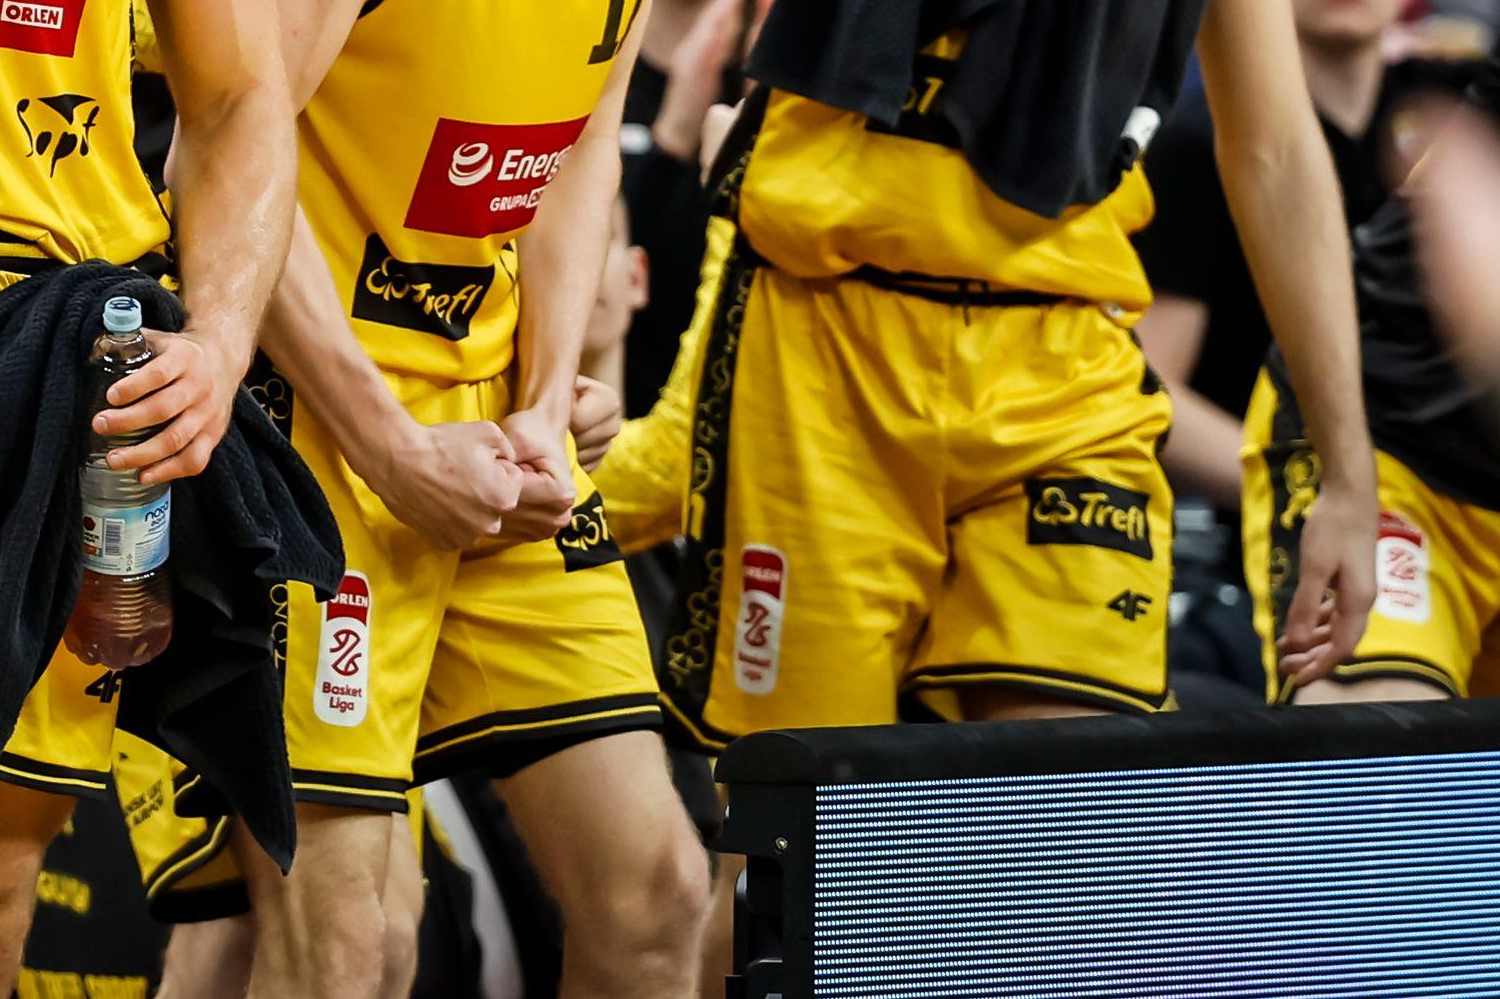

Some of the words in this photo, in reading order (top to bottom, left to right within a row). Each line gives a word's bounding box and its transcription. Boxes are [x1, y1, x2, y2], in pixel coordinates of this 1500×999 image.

[5, 5, 60, 26] ORLEN
[489, 194, 526, 212] GRUPA
[412, 283, 484, 326] Trefl
[1079, 492, 1145, 541] Trefl
[1106, 588, 1153, 622] 4F
[322, 681, 363, 698] Basket
[329, 696, 355, 714] Liga
